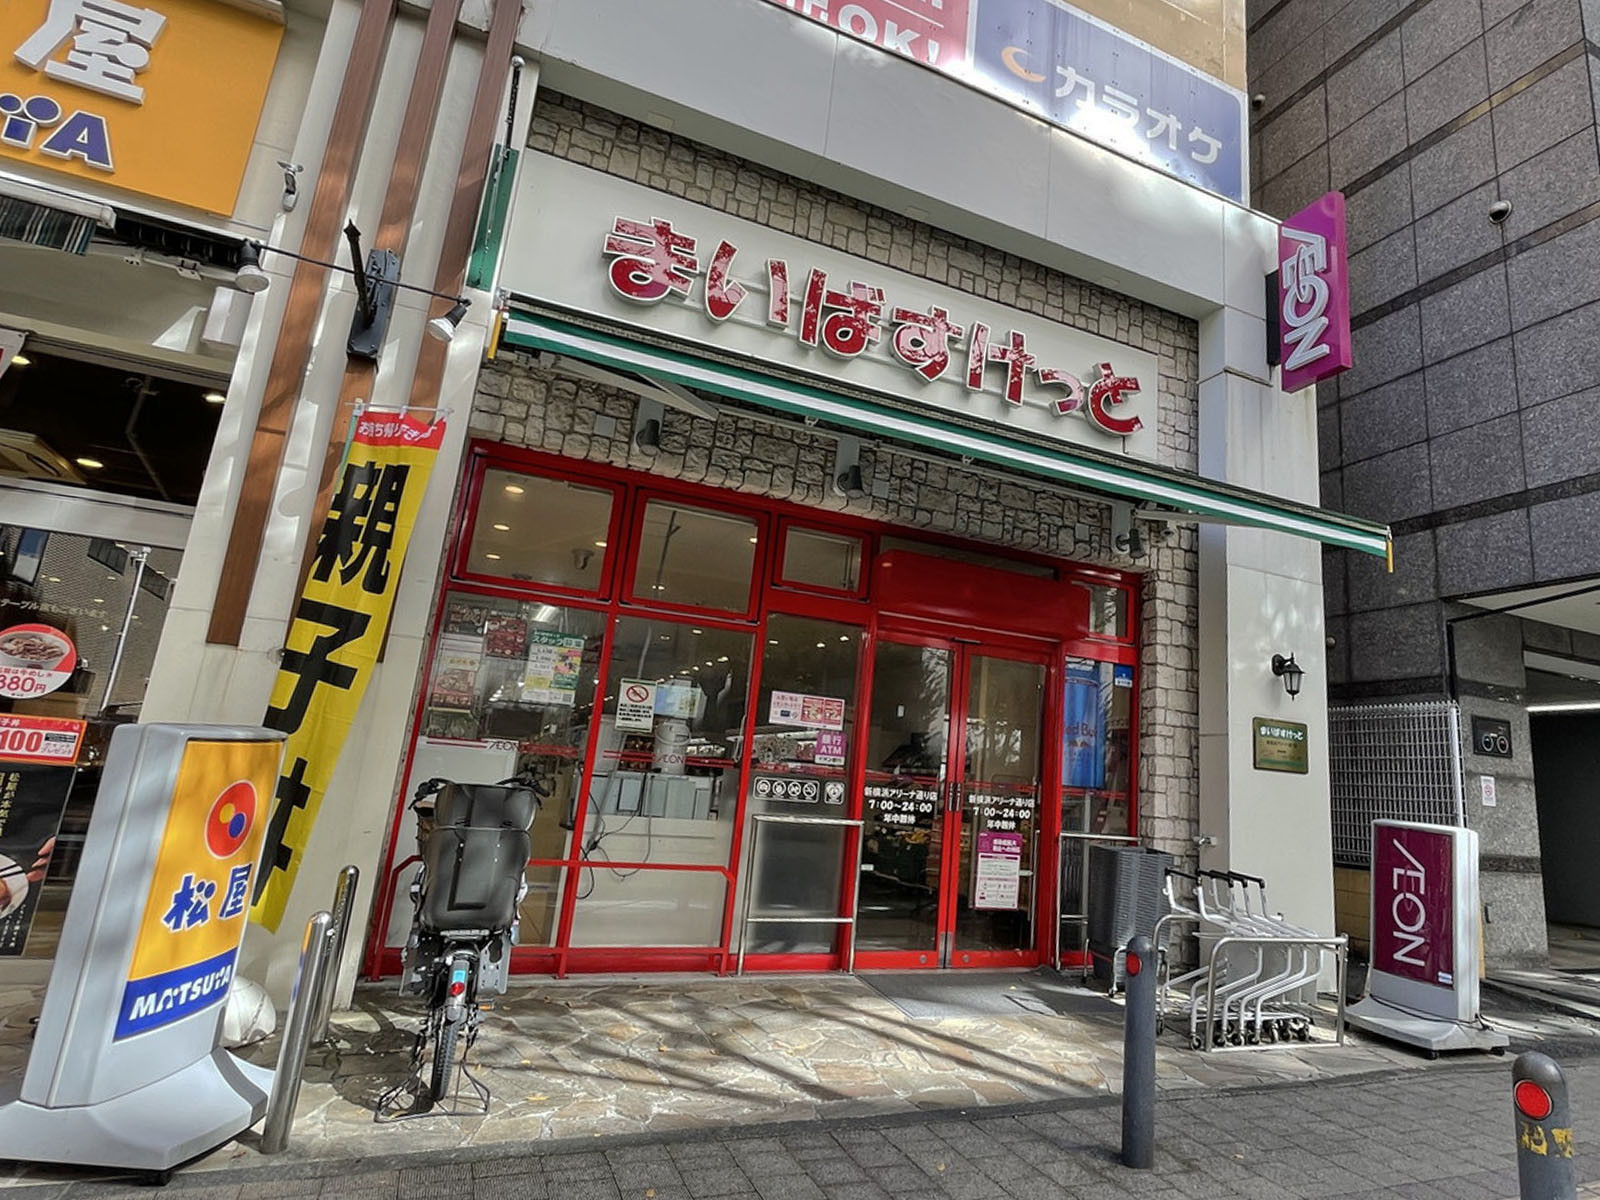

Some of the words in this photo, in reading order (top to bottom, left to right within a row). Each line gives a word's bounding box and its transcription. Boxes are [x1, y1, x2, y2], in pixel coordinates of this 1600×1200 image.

[1056, 65, 1223, 165] カラオケ
[602, 215, 1144, 437] まいばすけっと
[820, 745, 842, 755] ATM
[864, 786, 938, 801] 新横浜アリーナ通り店
[883, 813, 916, 825] 年中無休
[986, 819, 1016, 830] 年中無休
[161, 863, 253, 933] 松屋
[1392, 838, 1426, 967] AEON
[129, 963, 232, 1021] MATSUYA
